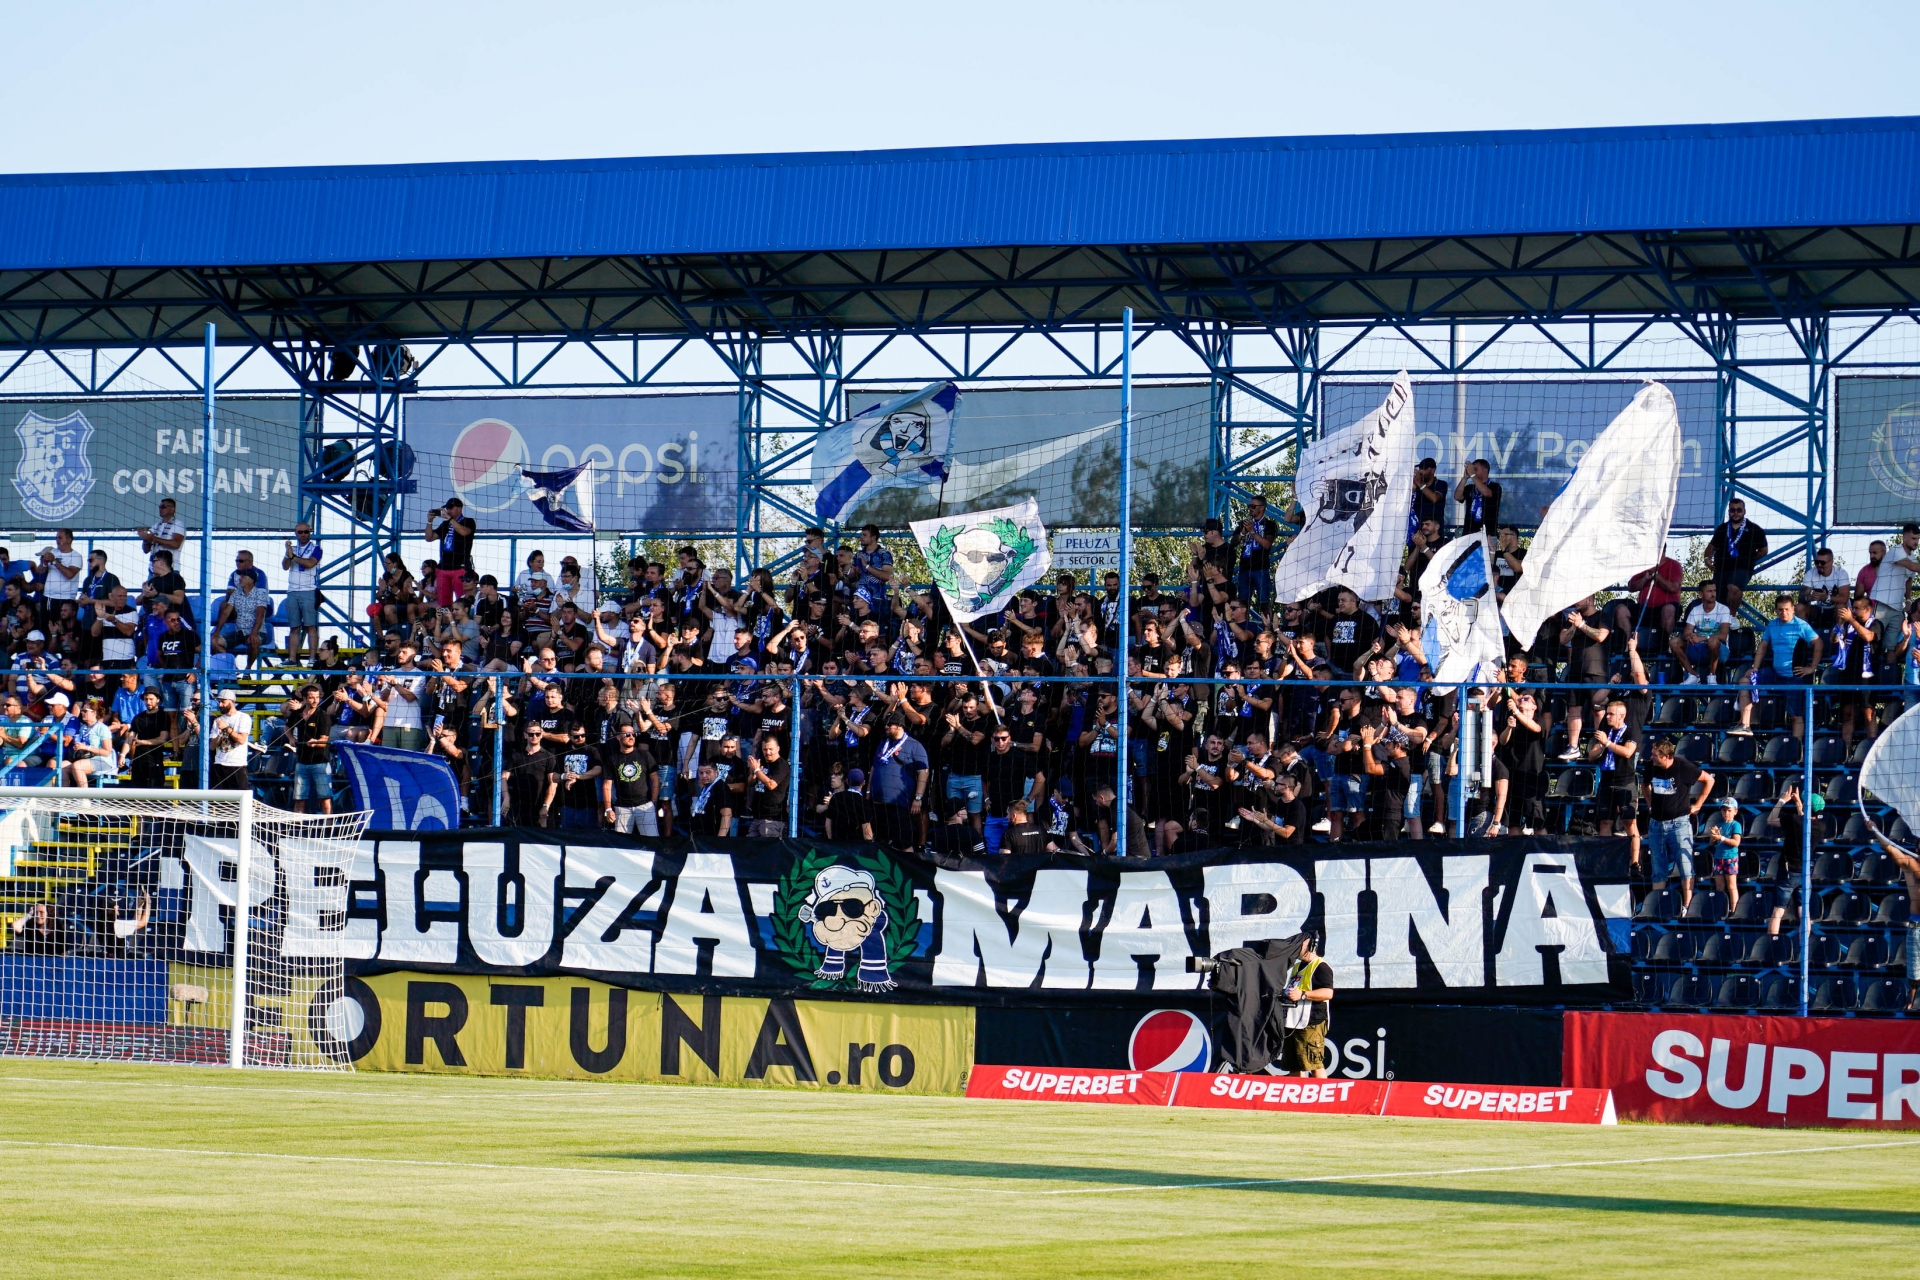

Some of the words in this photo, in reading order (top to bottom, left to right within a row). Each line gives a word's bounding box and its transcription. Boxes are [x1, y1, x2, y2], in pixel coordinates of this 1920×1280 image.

[156, 428, 251, 455] FARUL
[1414, 430, 1520, 470] OMV
[1065, 538, 1110, 549] PELUZA
[1069, 556, 1105, 566] SECTOR
[1110, 556, 1117, 565] C
[183, 833, 756, 979] PELUZA
[1001, 1068, 1143, 1095] SUPERBET
[1210, 1075, 1355, 1104] SUPERBET
[1423, 1085, 1573, 1113] SUPERBET
